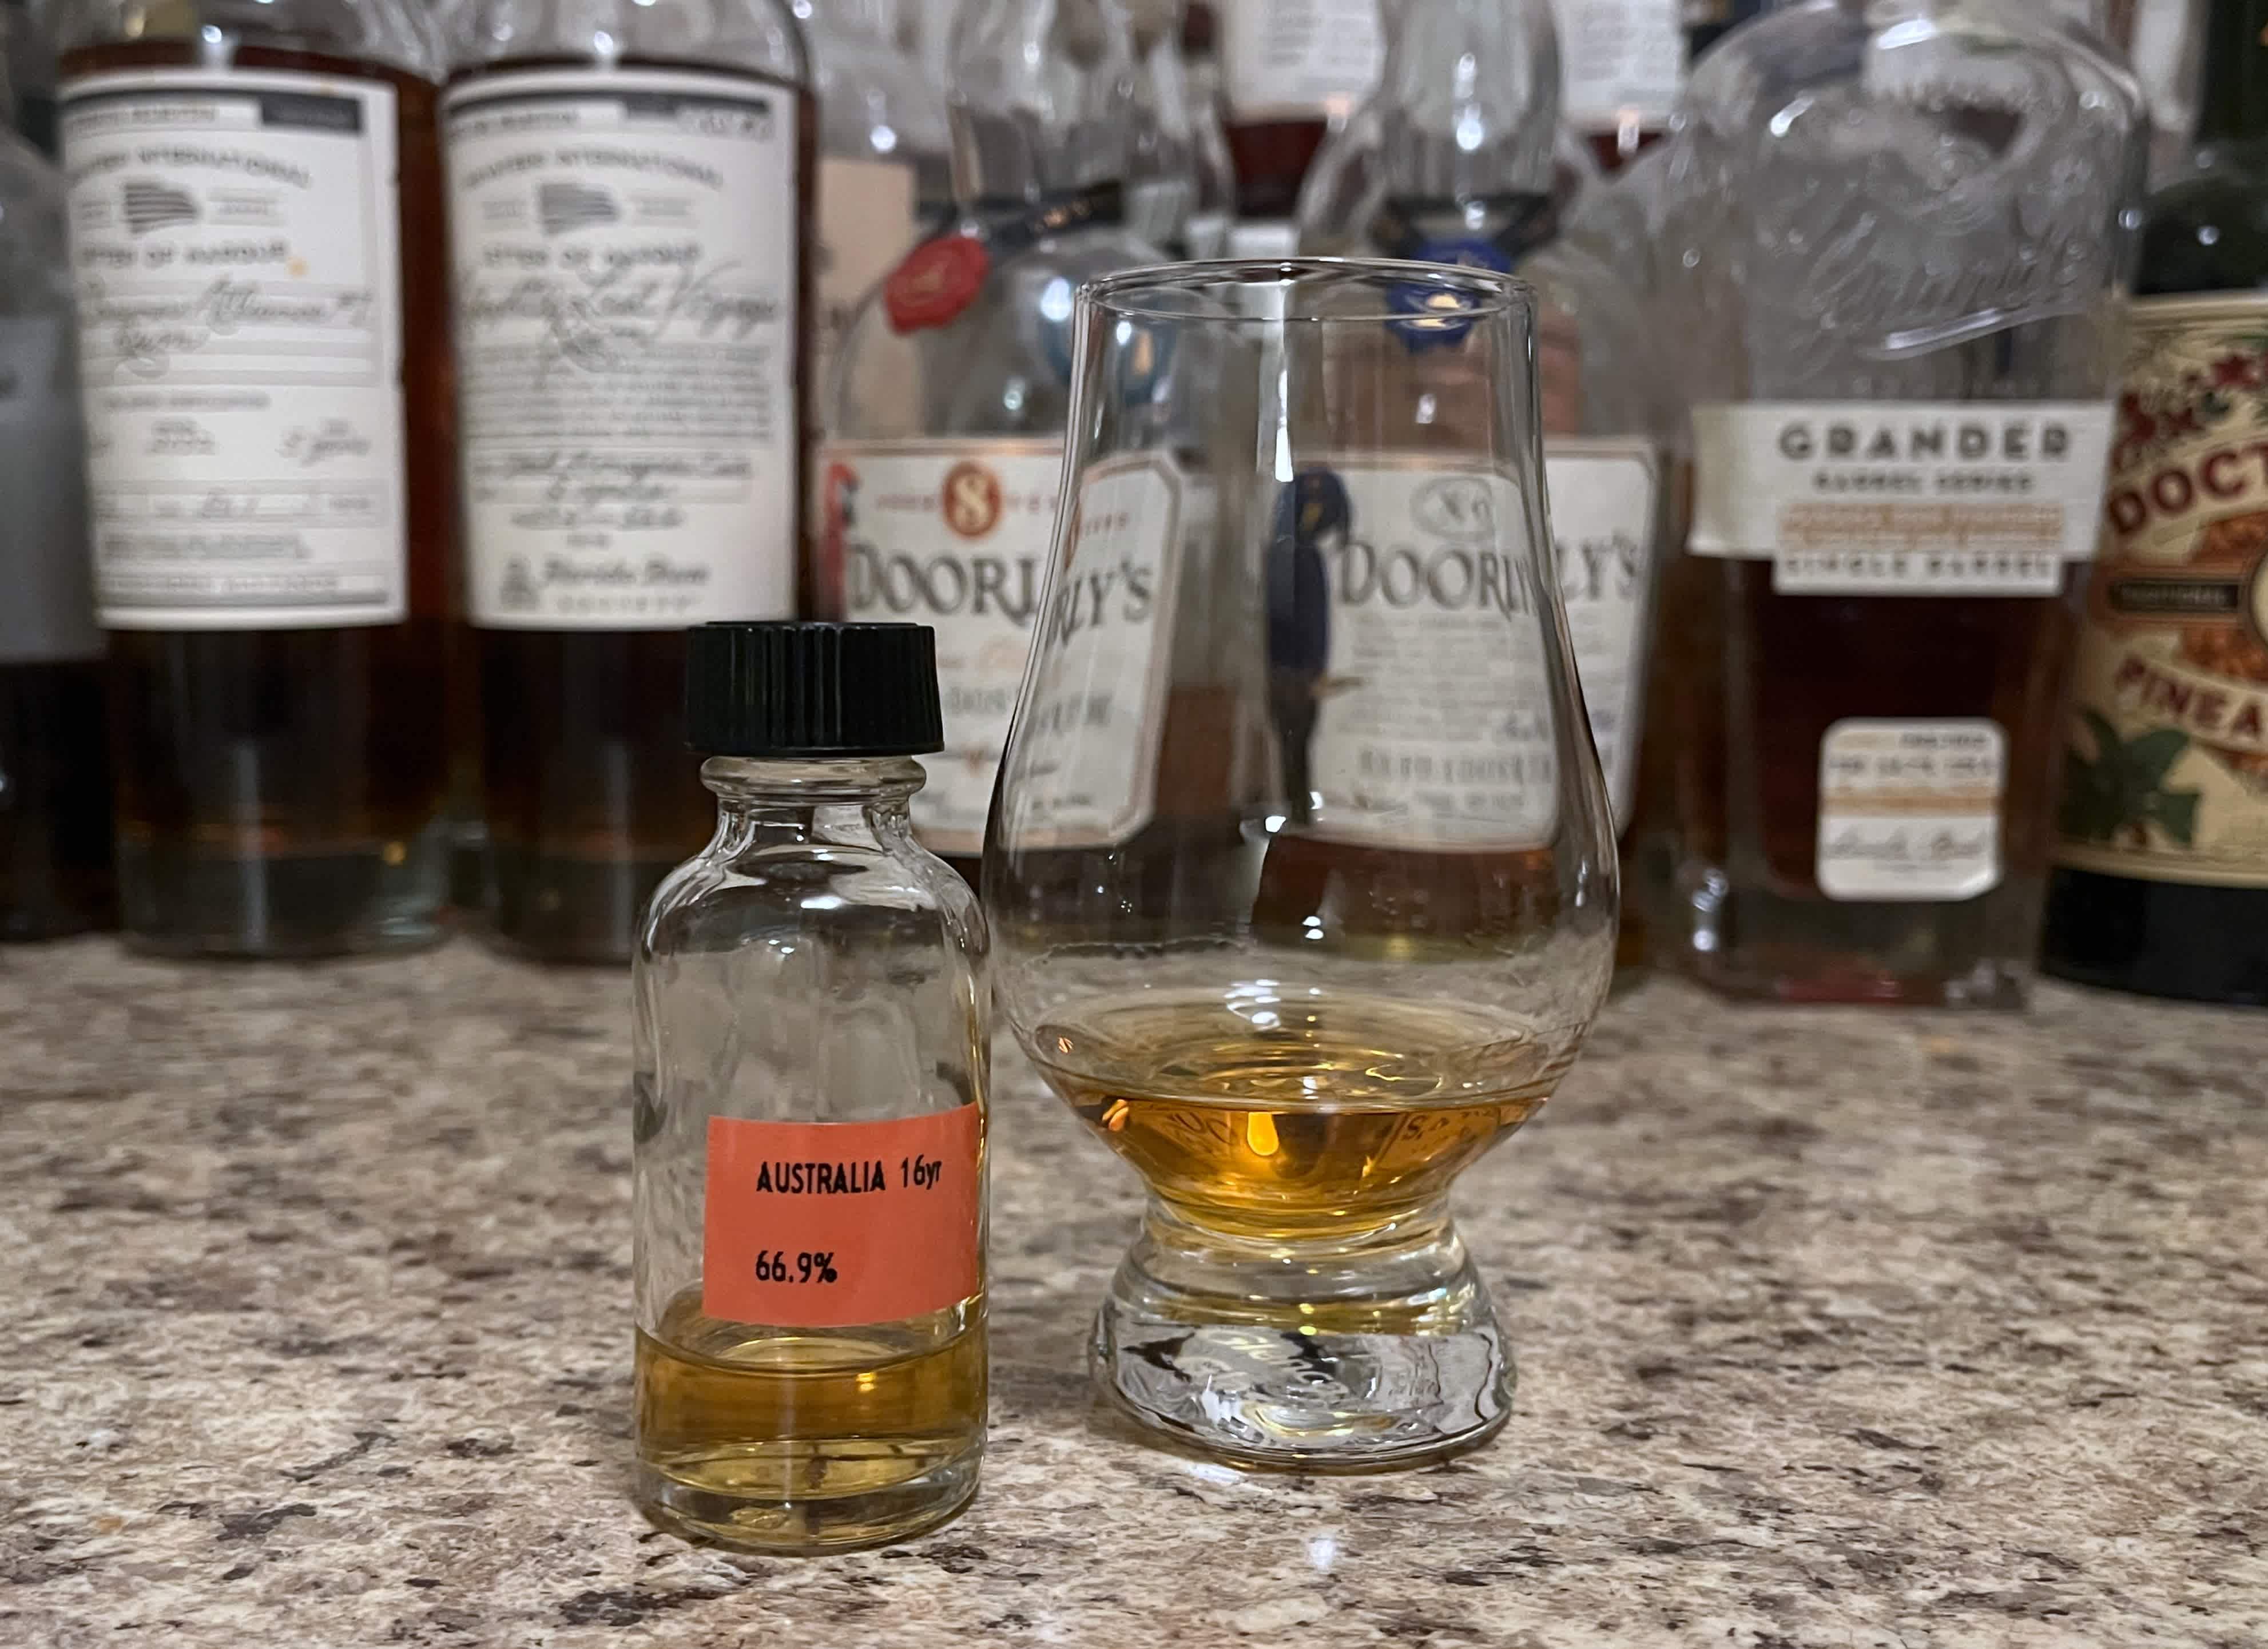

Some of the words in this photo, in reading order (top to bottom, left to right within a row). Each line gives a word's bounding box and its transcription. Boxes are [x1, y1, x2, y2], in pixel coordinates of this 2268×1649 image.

[1779, 423, 2071, 459] GRANDER
[951, 466, 993, 532] 8
[756, 1161, 886, 1194] AUSTRALIA
[900, 1154, 943, 1190] 16yr
[756, 1250, 837, 1283] 66.9%
